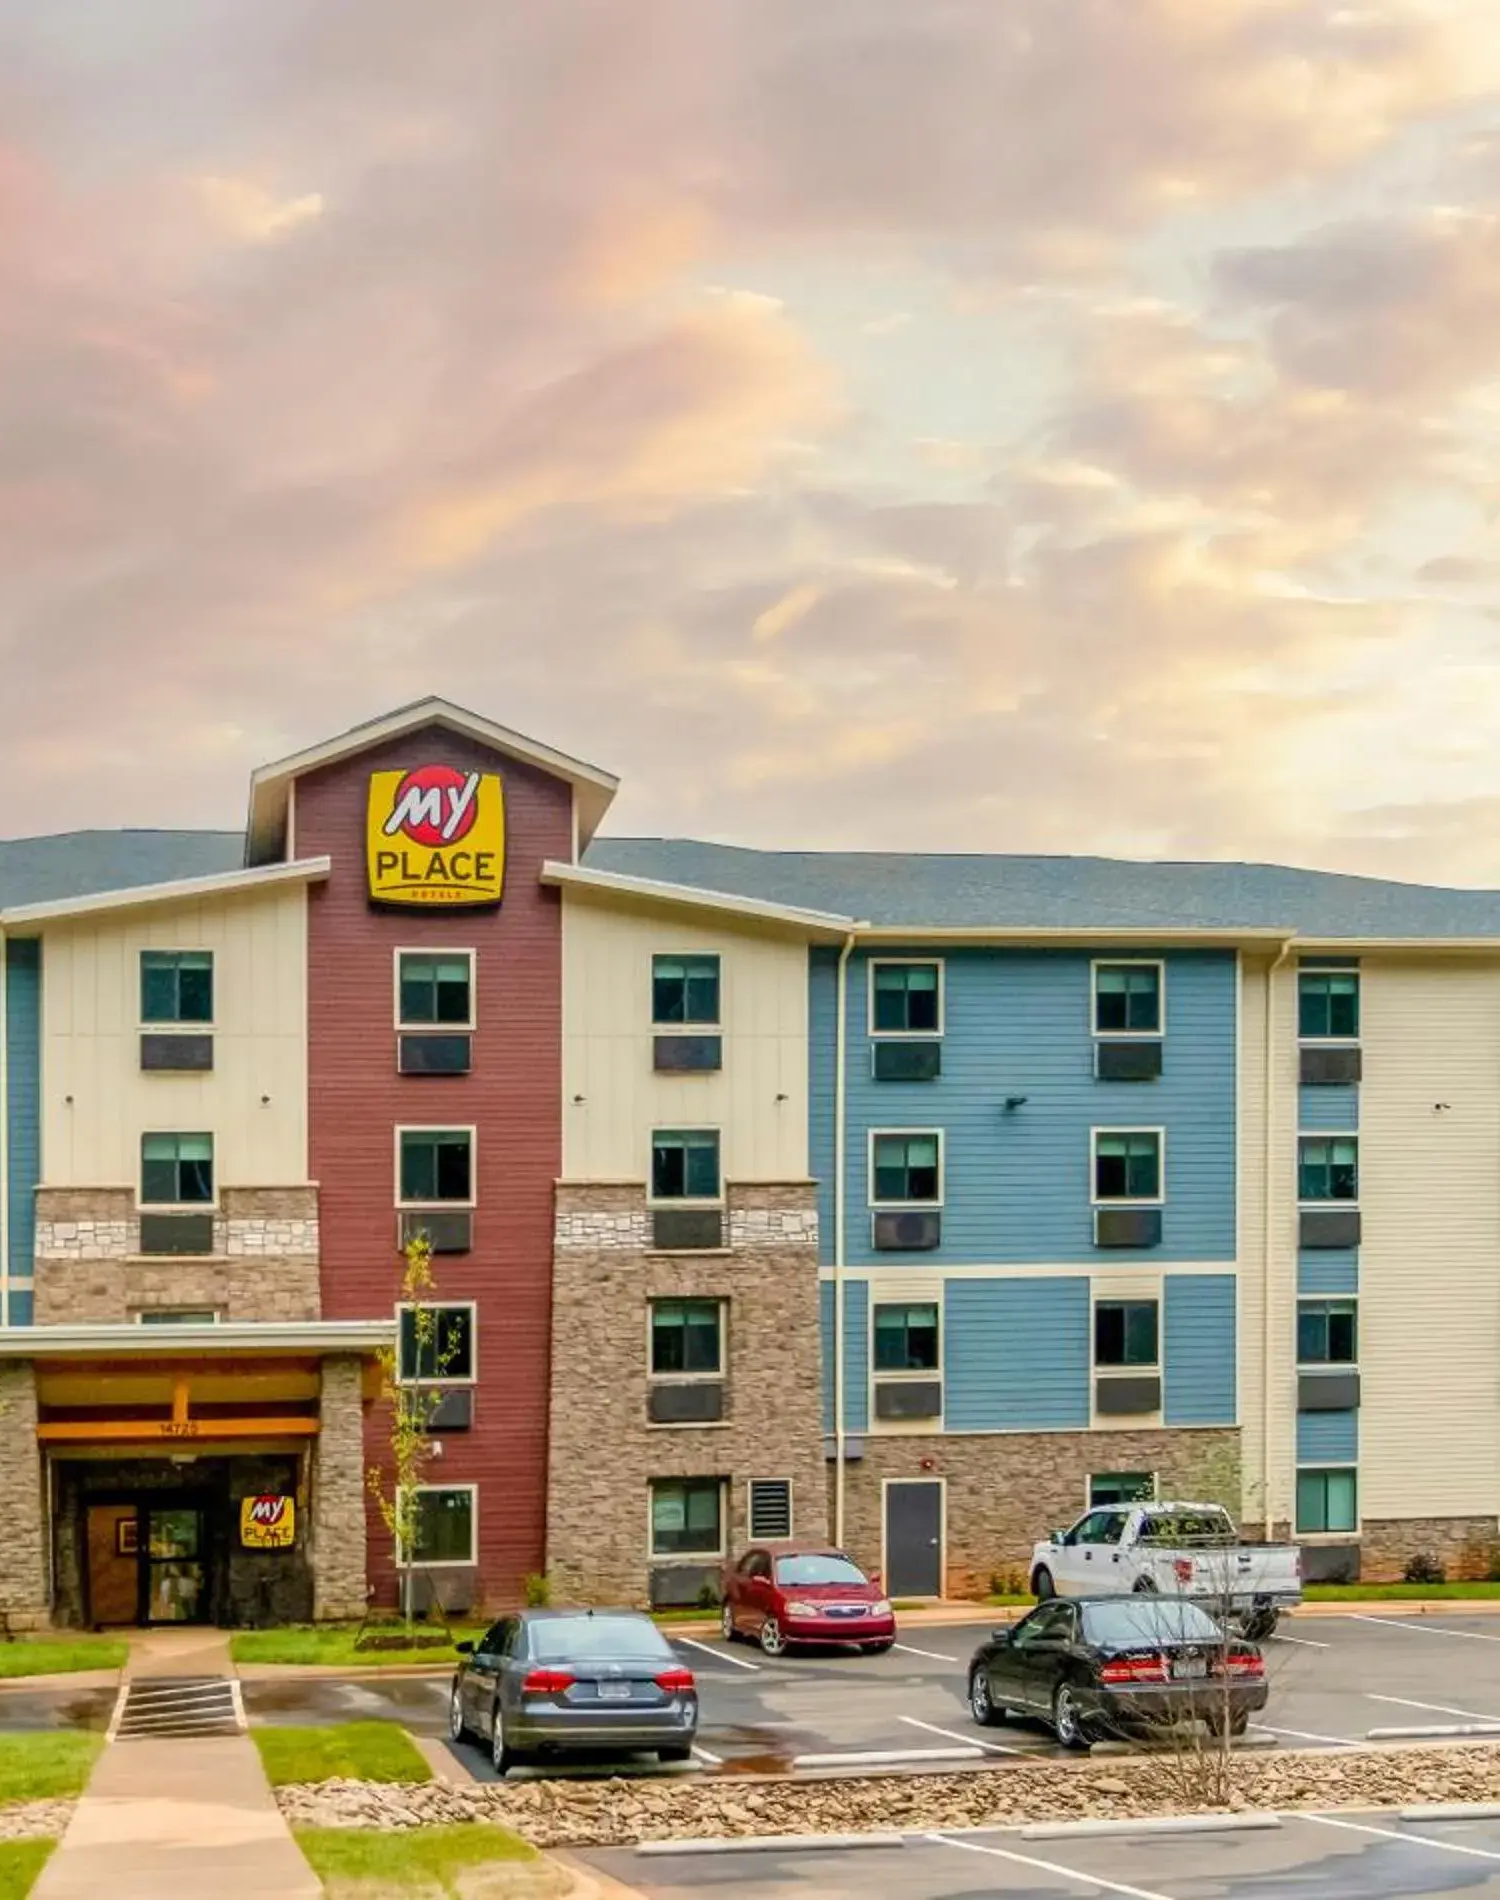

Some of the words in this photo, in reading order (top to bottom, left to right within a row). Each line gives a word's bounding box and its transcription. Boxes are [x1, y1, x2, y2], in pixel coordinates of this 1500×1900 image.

[384, 772, 480, 838] MY
[377, 851, 496, 881] PLACE
[249, 1496, 285, 1523] MY
